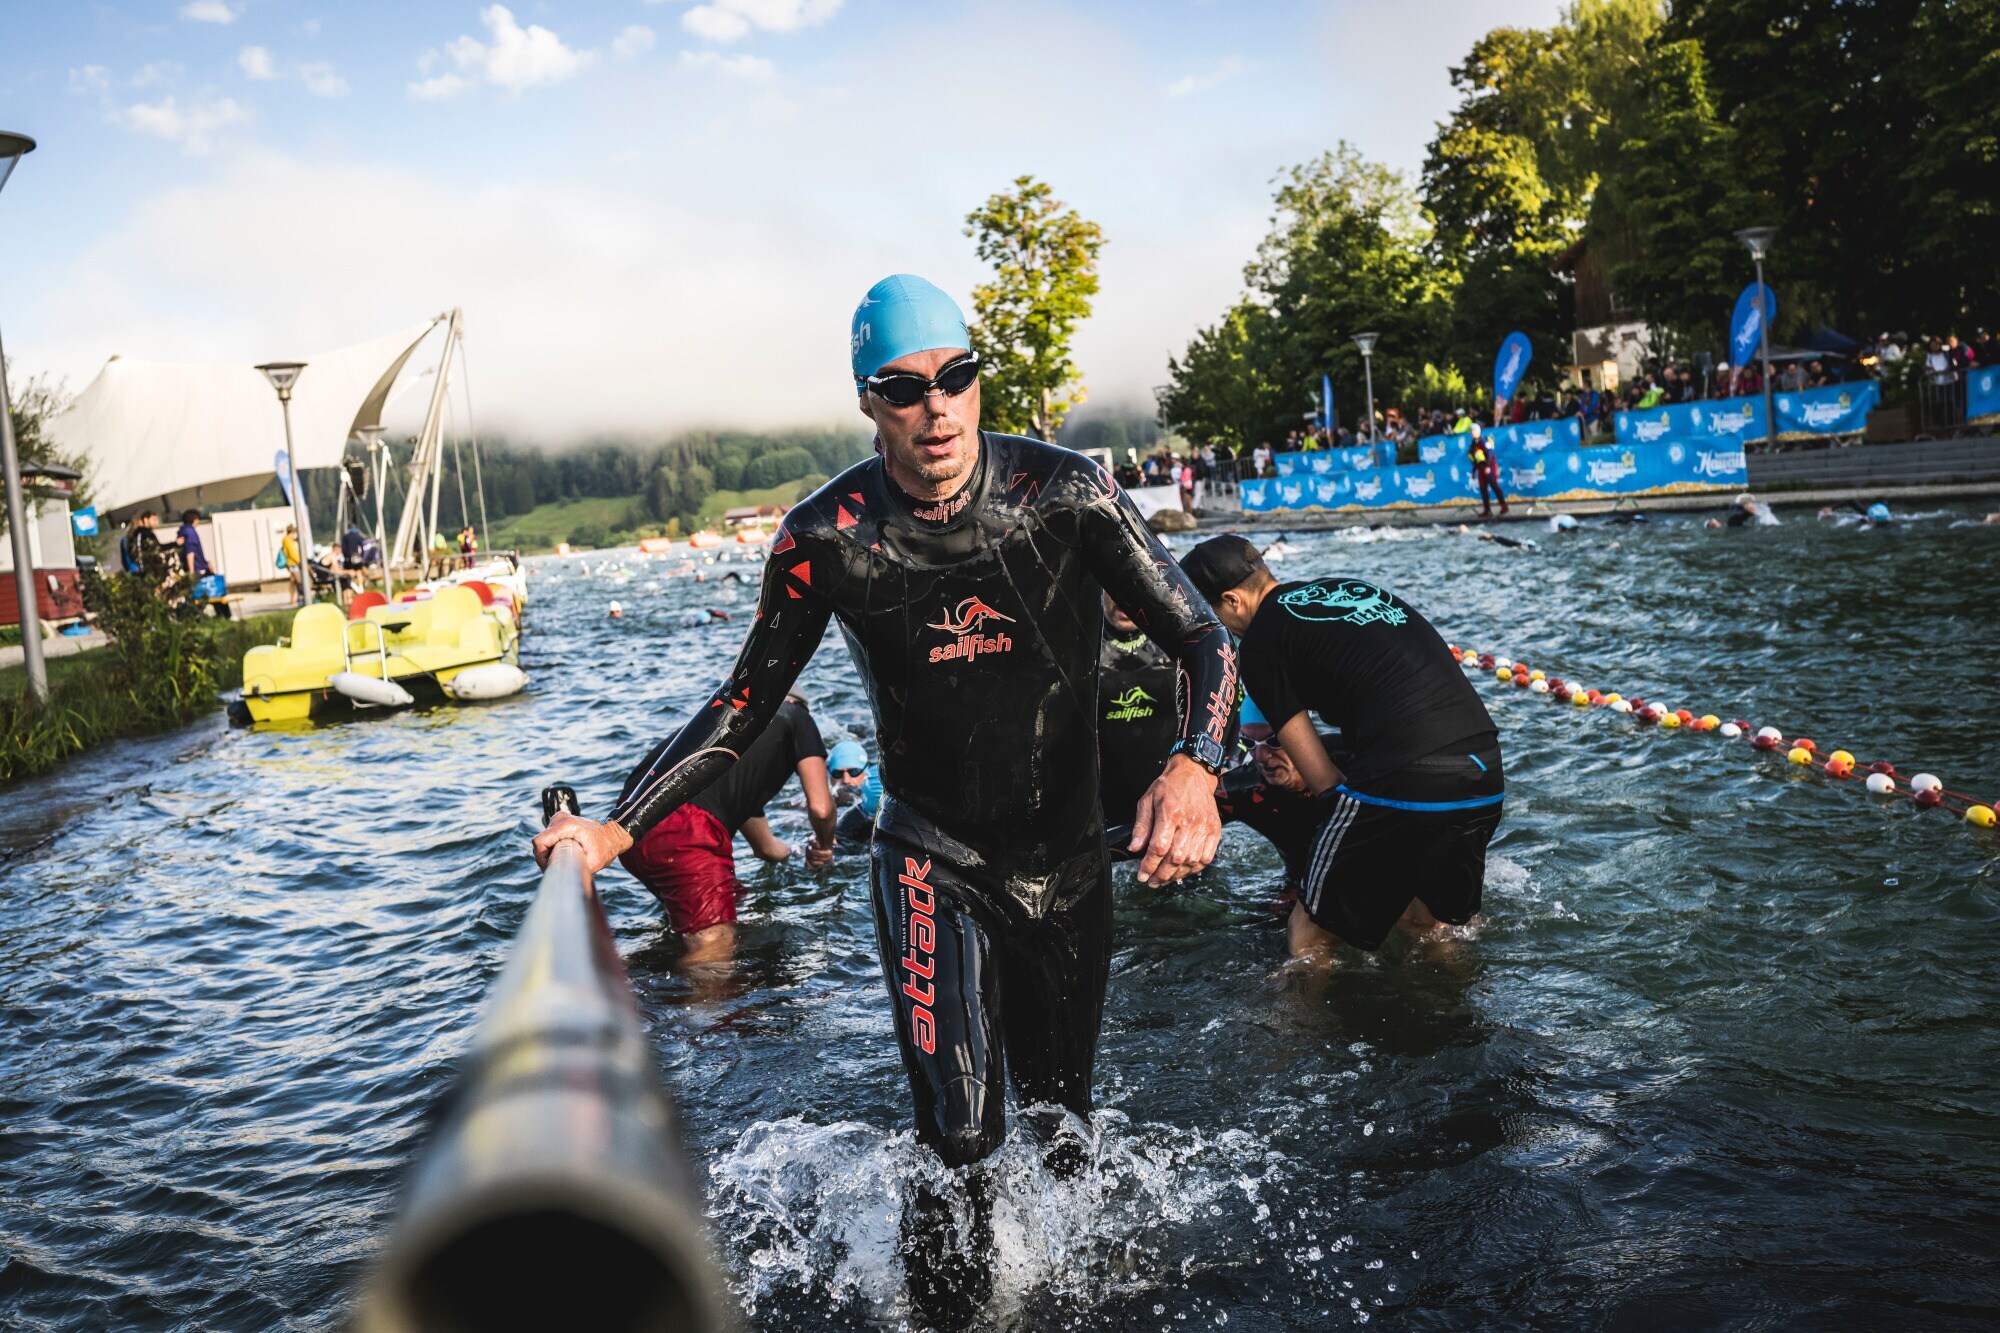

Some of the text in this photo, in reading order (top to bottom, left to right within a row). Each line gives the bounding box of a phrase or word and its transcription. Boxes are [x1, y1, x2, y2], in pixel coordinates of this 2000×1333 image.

[913, 490, 972, 523] sailfish
[928, 632, 1012, 663] sailfish
[1106, 706, 1153, 723] sailfish
[898, 856, 936, 1055] attack
